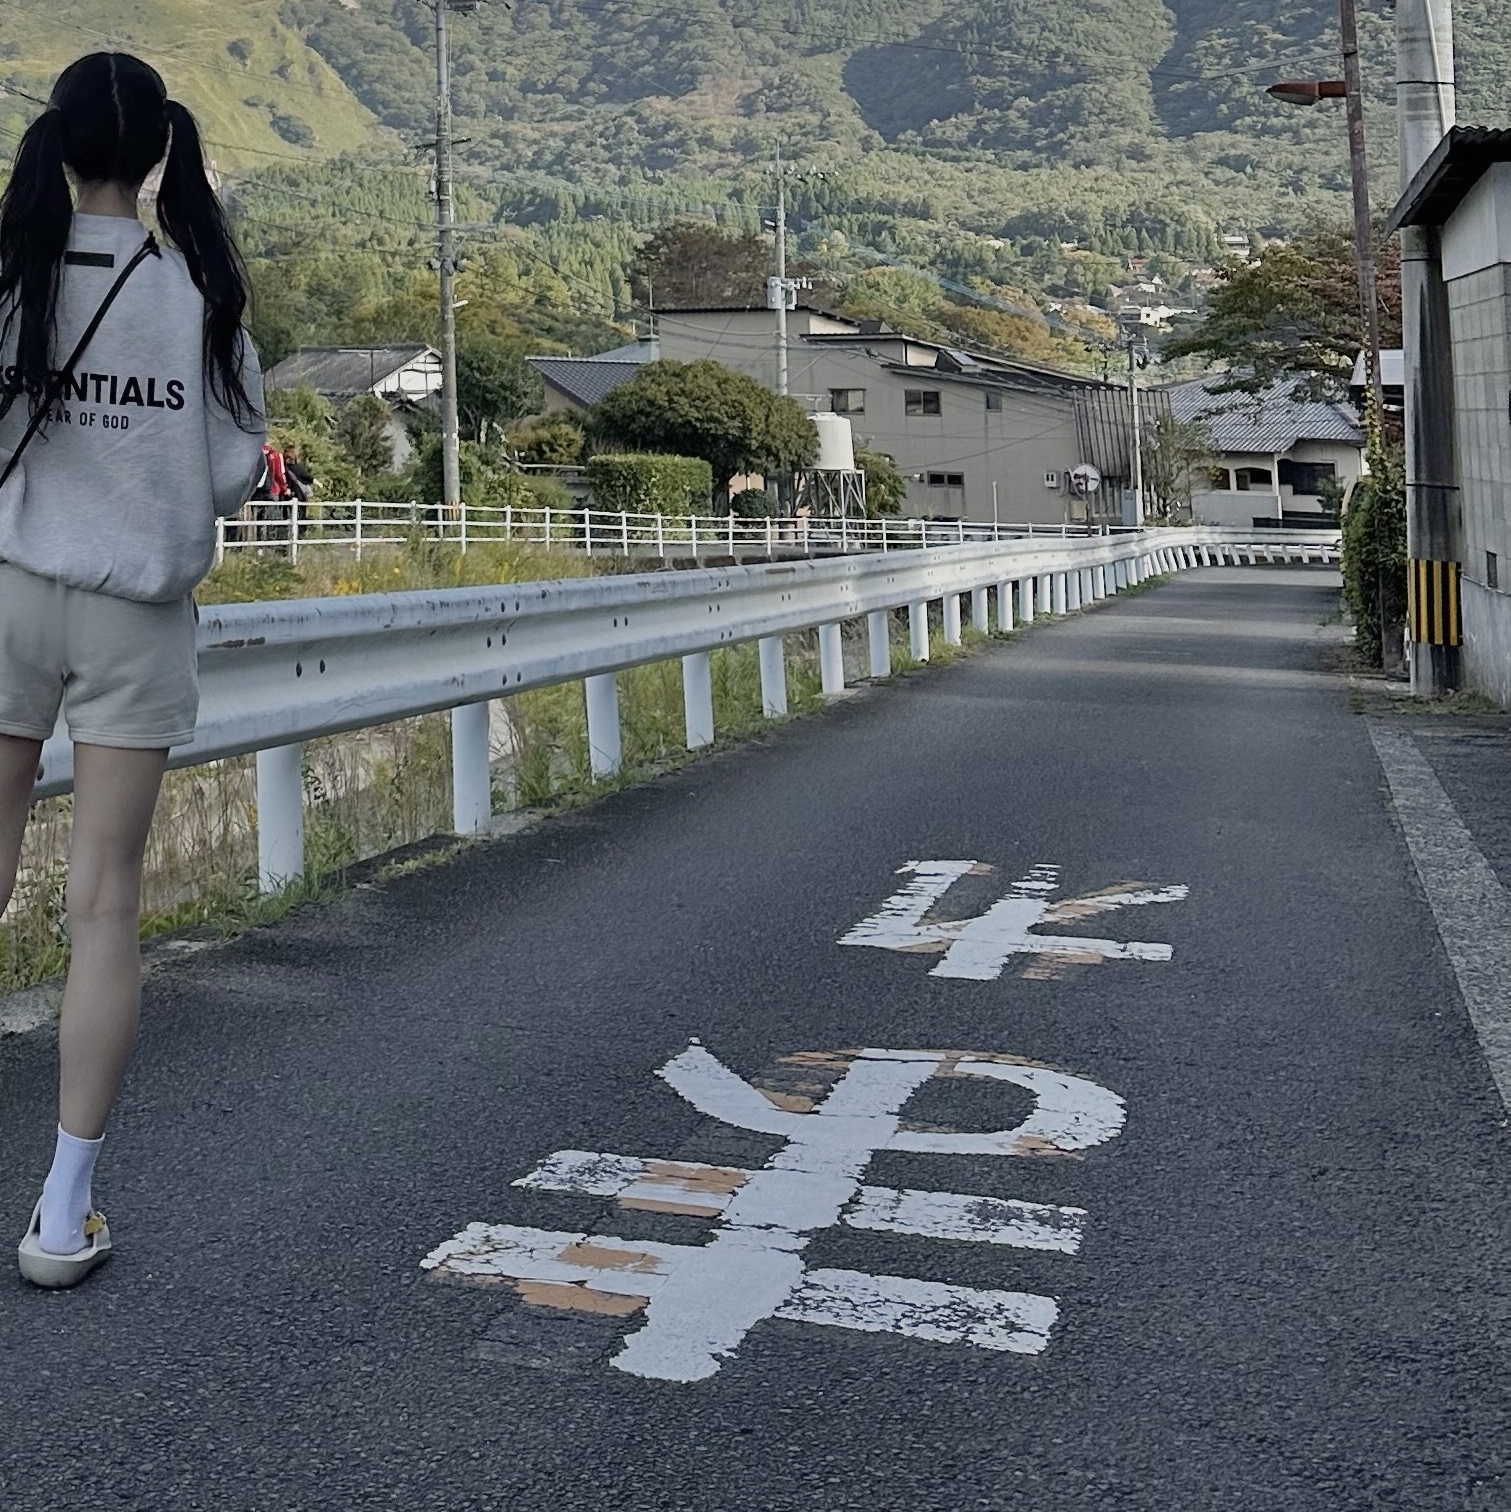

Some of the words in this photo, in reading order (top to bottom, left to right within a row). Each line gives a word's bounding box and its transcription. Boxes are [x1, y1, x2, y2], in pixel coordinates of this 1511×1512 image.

[38, 407, 72, 425] EAR
[79, 411, 97, 427] OF
[102, 413, 130, 430] GOD
